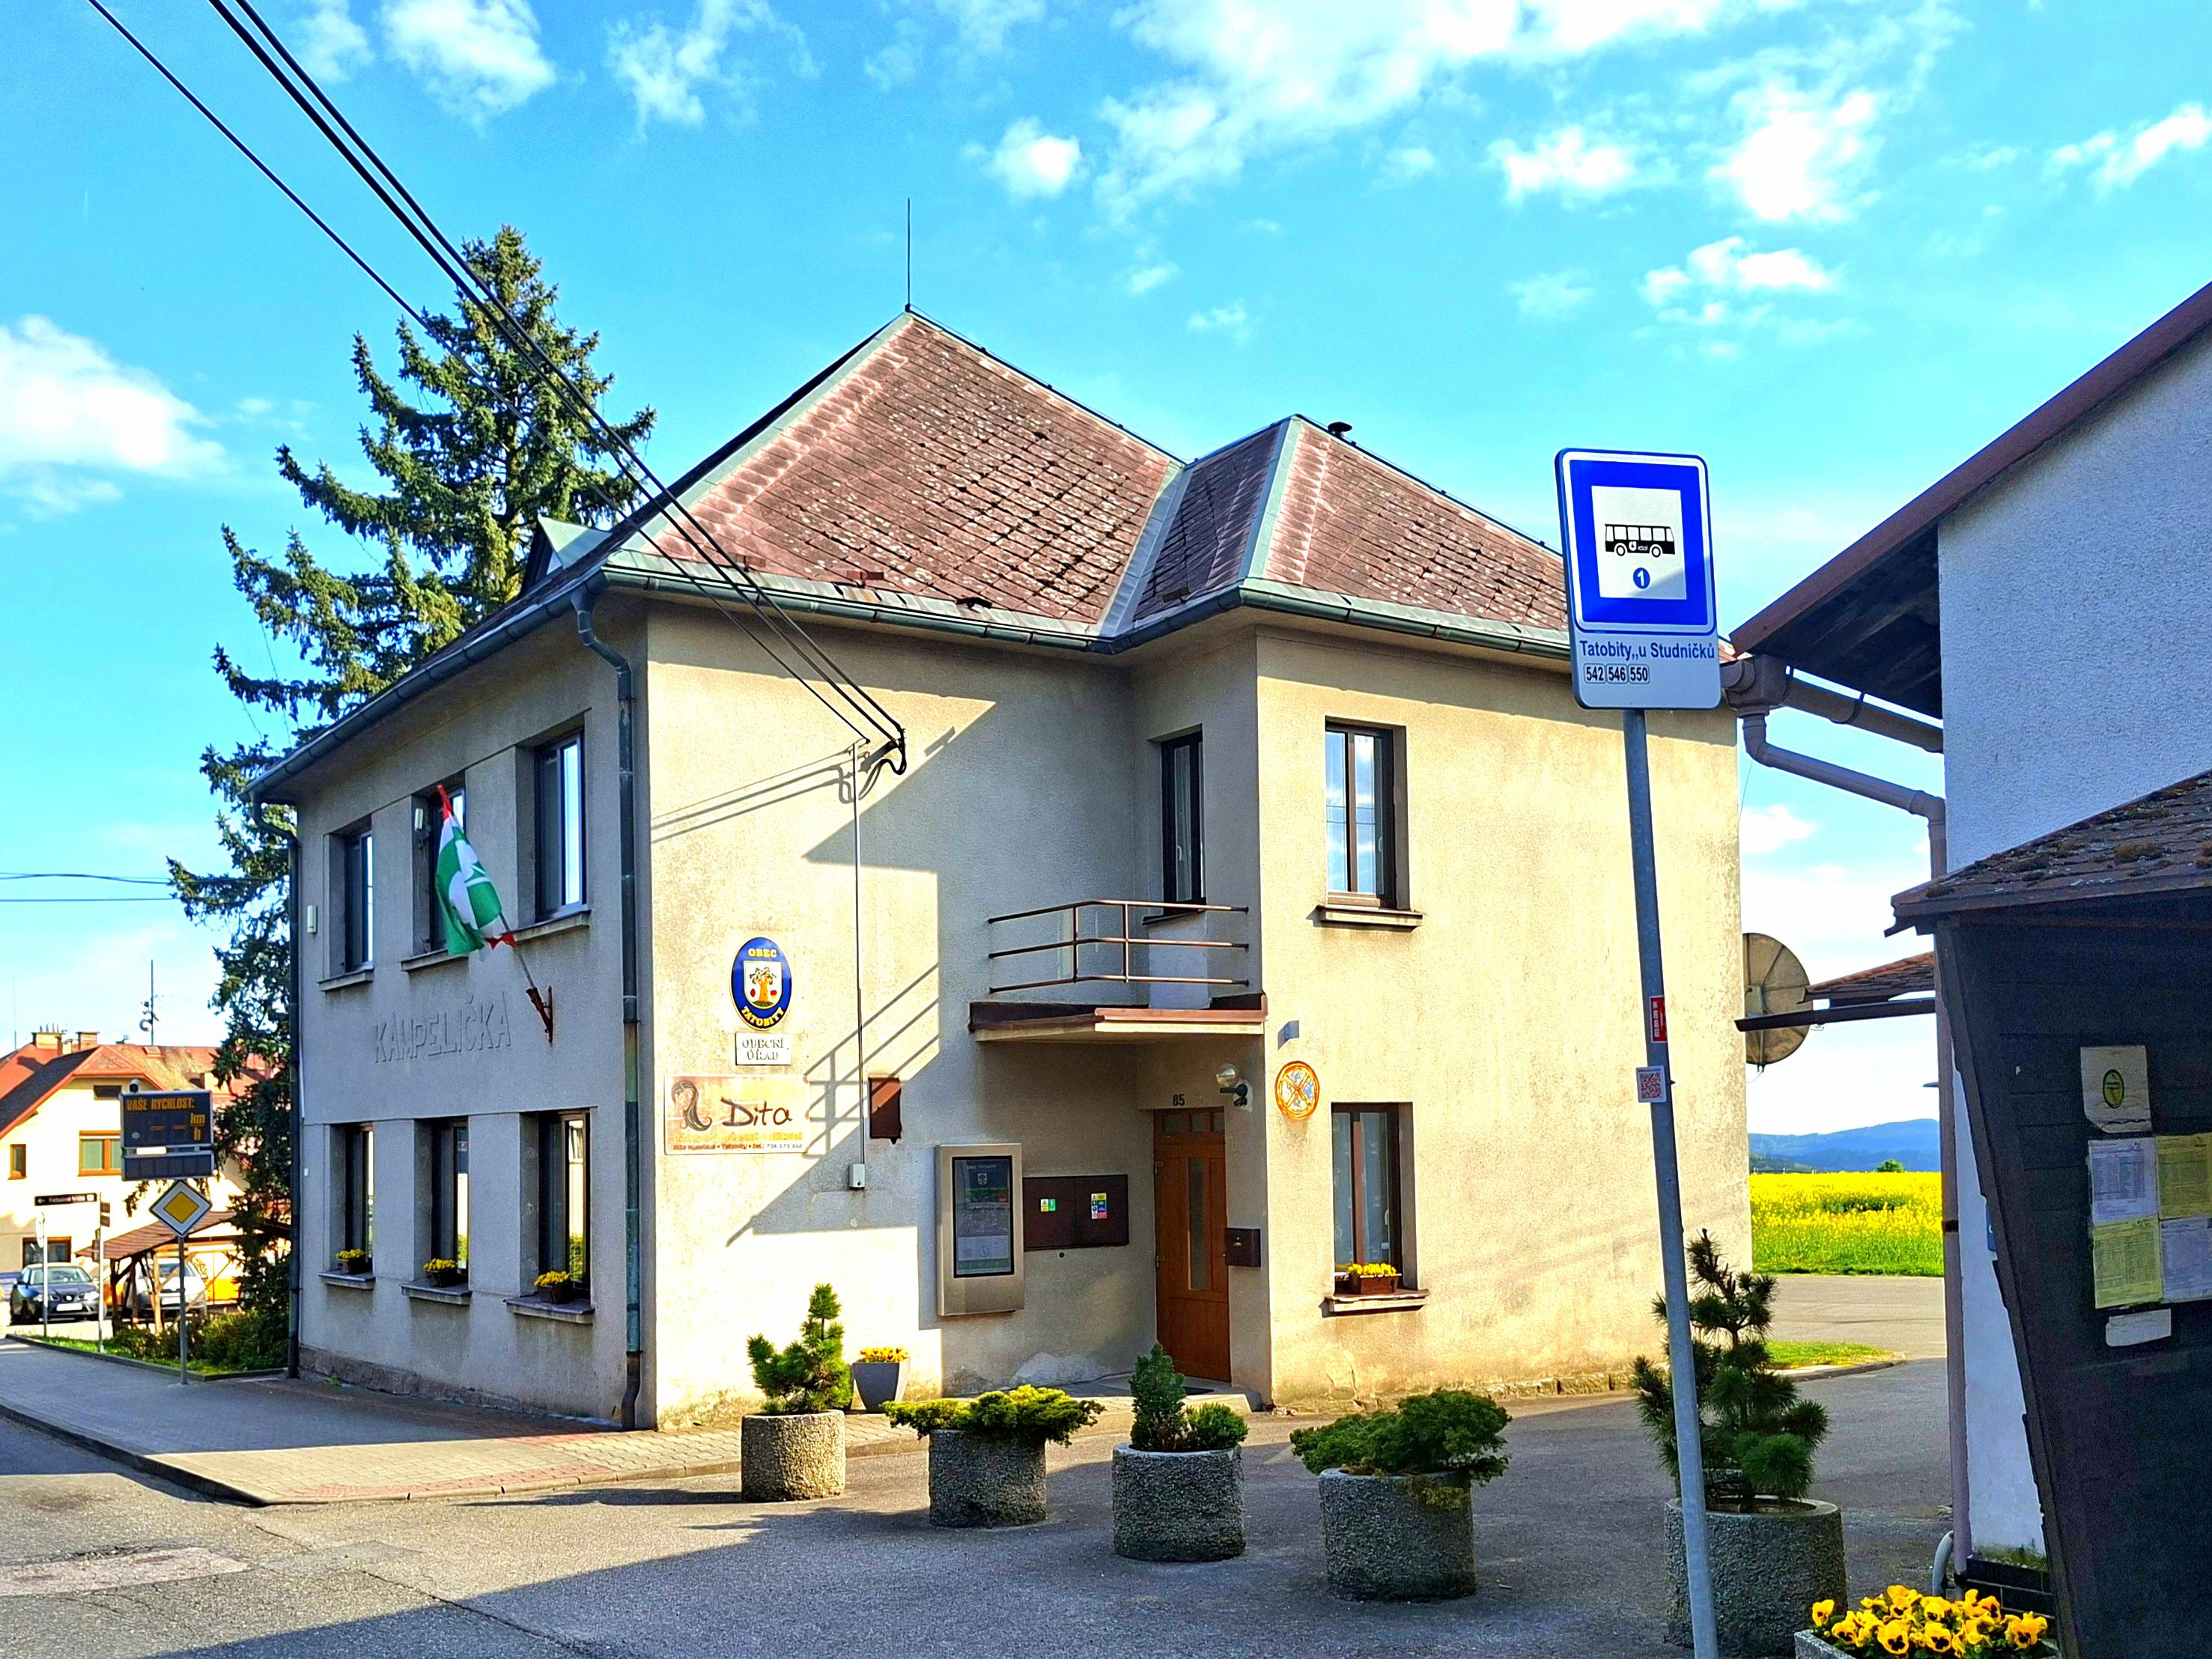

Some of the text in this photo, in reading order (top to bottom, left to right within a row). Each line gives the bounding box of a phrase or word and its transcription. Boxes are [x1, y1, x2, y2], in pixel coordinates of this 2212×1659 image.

[1637, 570, 1646, 588] 1
[1650, 641, 1716, 660] Studničků
[1586, 666, 1649, 682] 542 546 550
[747, 948, 778, 958] OBEC
[741, 1005, 786, 1026] TATOBITY
[127, 1097, 195, 1111] VAŠE RYCHLOST:
[1173, 1094, 1185, 1106] 85
[190, 1112, 206, 1124] km
[720, 1097, 793, 1126] Dita
[193, 1127, 201, 1141] h
